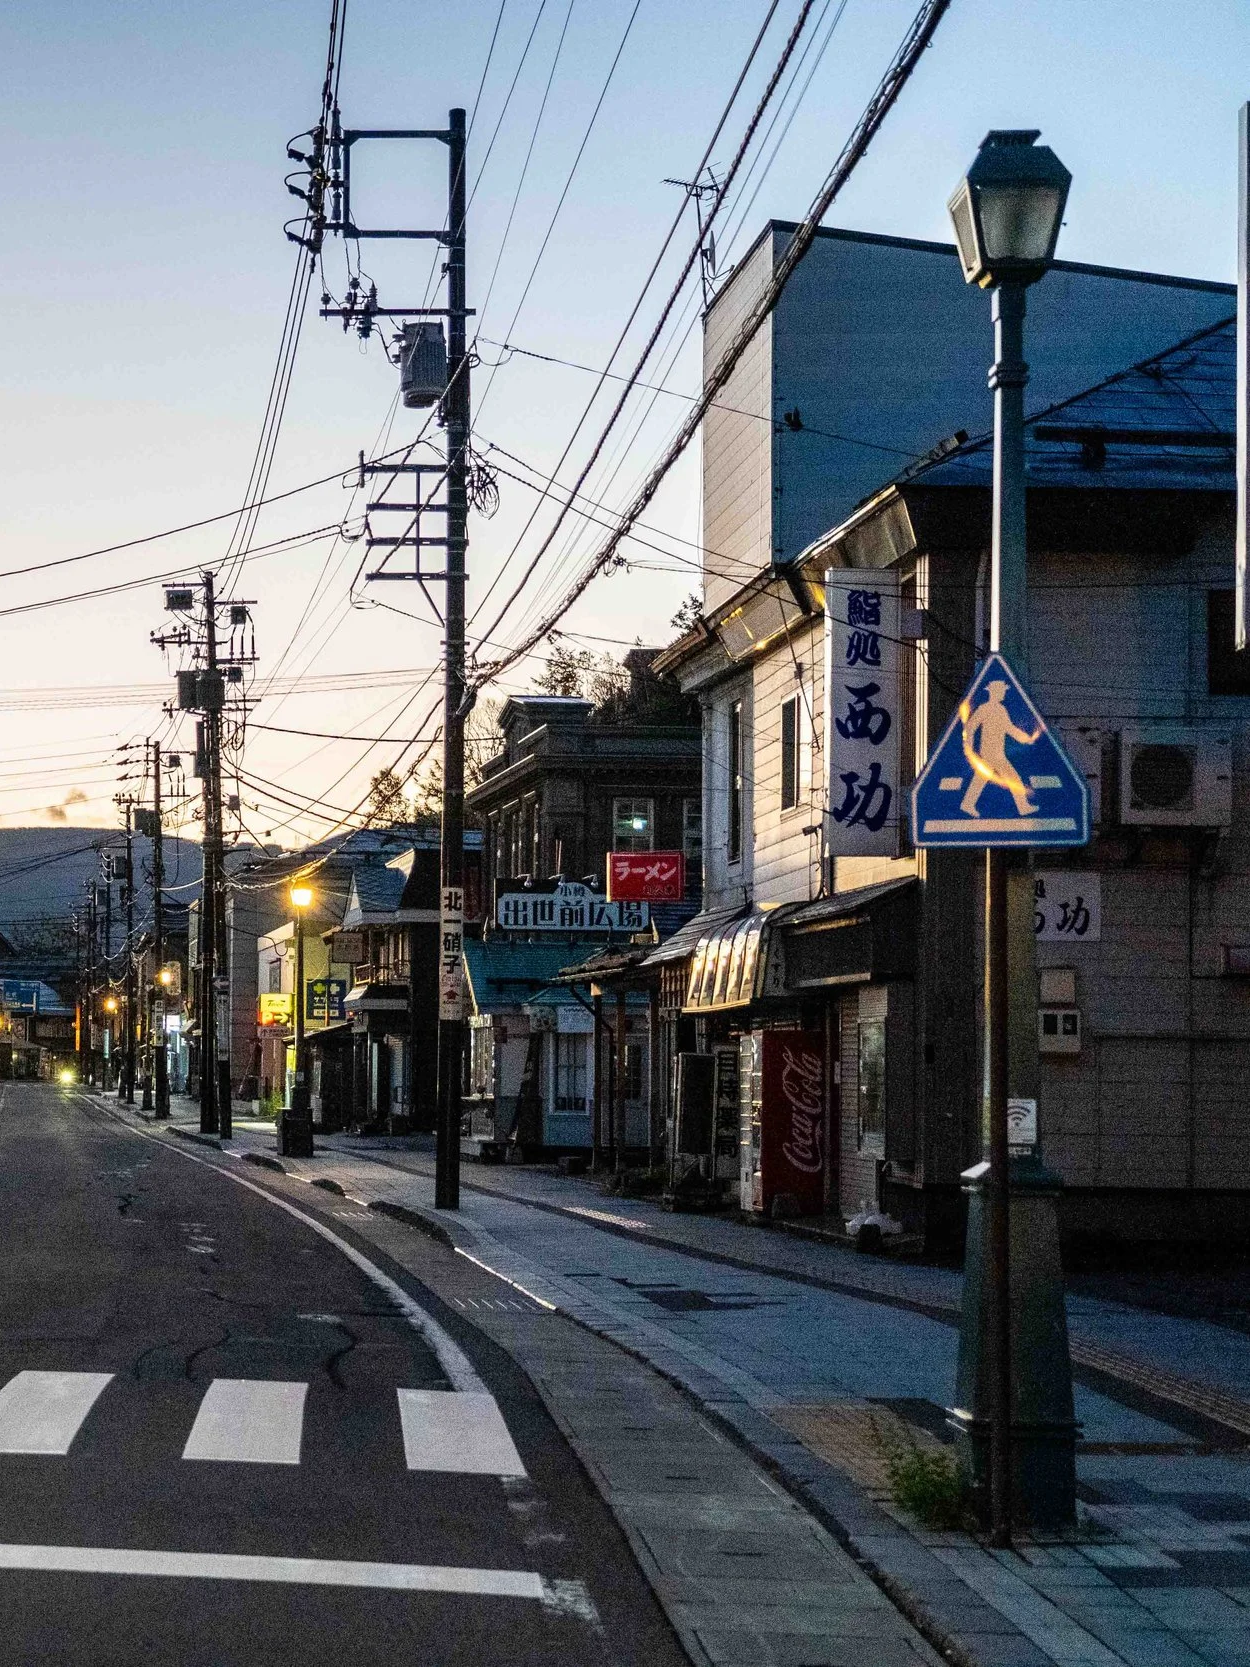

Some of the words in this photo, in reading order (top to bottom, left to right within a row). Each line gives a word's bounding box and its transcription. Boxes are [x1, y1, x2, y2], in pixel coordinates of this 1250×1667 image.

[614, 861, 677, 882] ラーメン
[559, 883, 587, 897] 小樽
[504, 900, 643, 928] 出世前広場
[442, 890, 462, 975] 北一硝子
[782, 1045, 823, 1173] Coca-Cola
